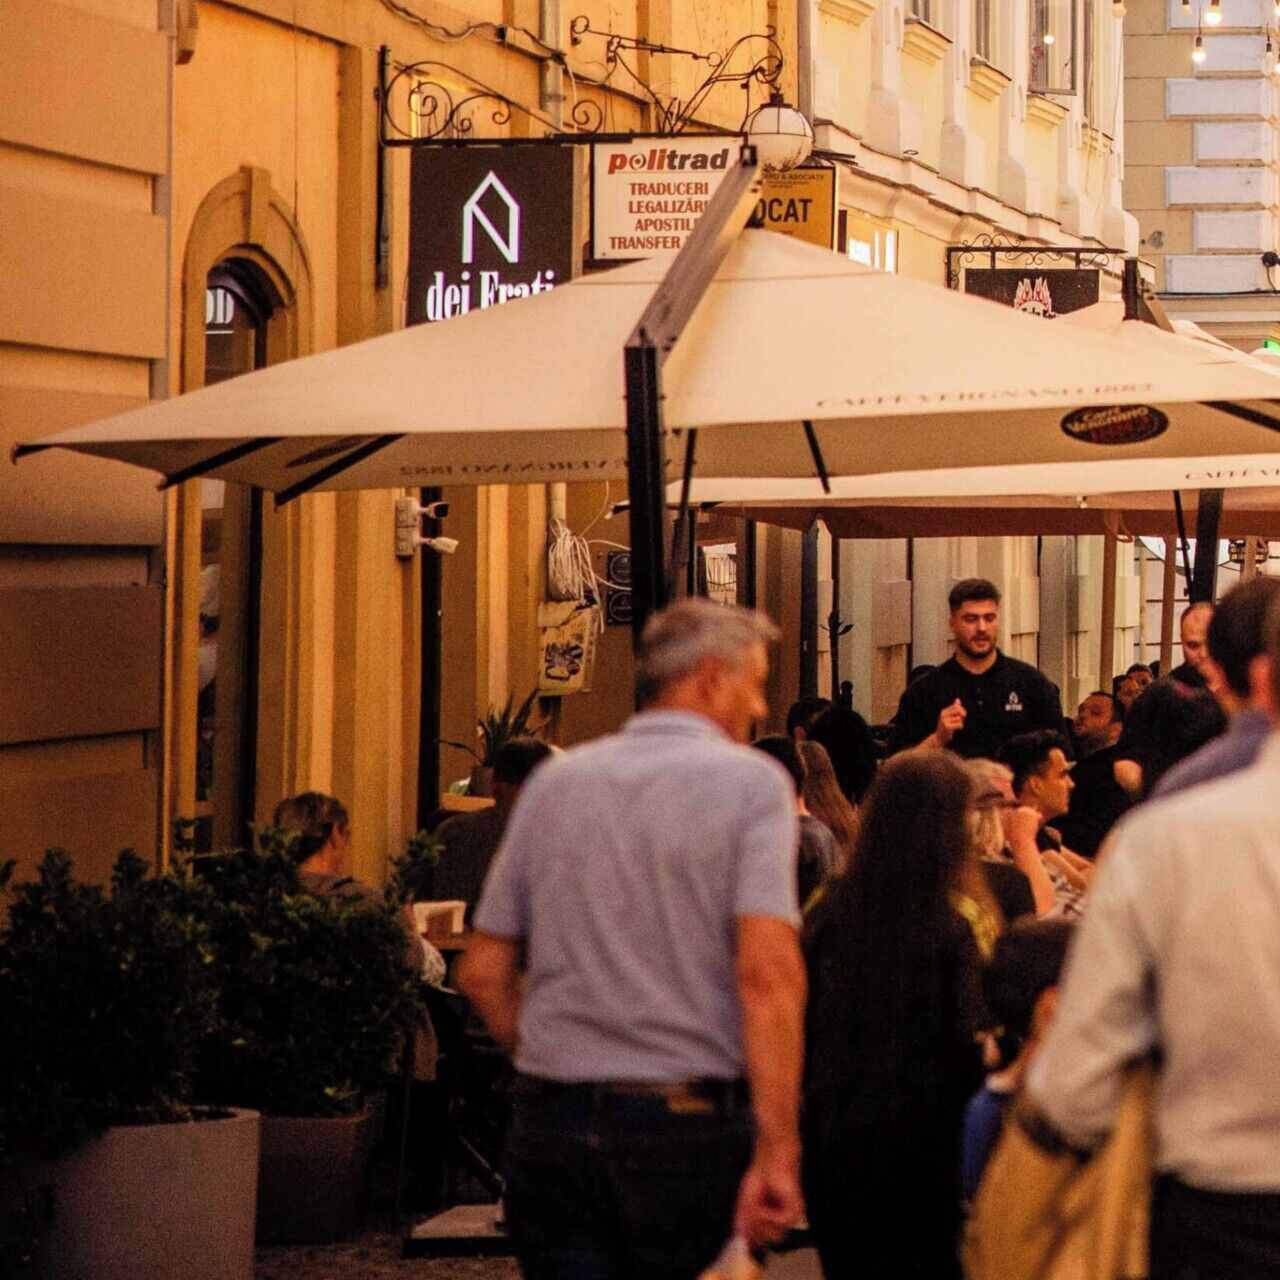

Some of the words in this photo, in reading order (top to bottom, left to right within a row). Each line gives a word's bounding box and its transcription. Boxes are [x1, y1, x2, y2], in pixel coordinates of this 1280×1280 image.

[608, 148, 730, 174] politrad
[629, 182, 709, 196] TRADUCERI
[756, 198, 813, 223] OCAT
[634, 218, 699, 232] APOSTIL
[608, 236, 681, 250] TRANSFER
[426, 271, 471, 321] dei
